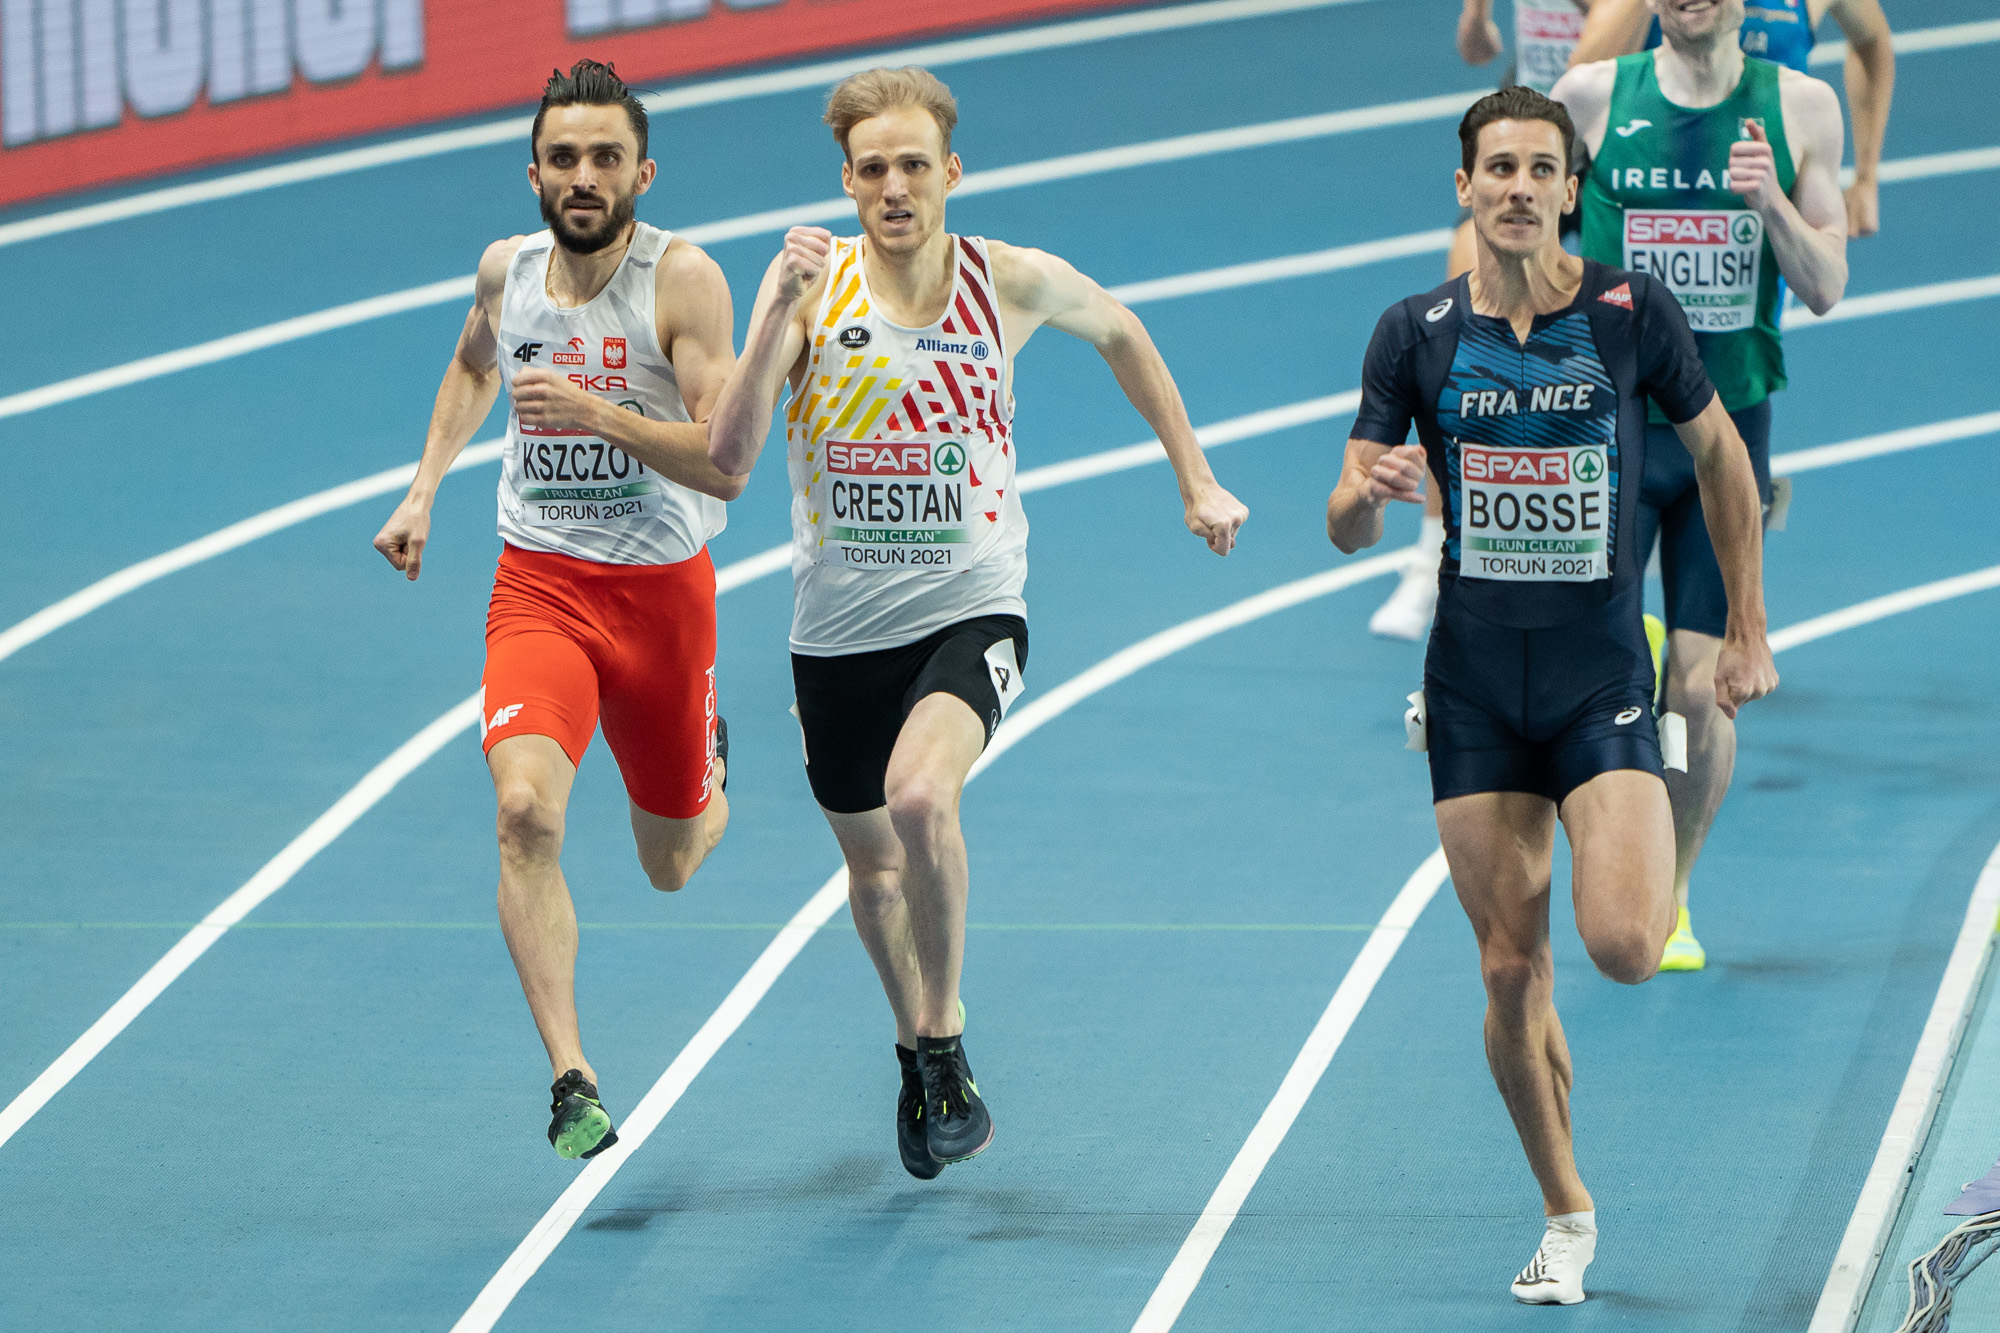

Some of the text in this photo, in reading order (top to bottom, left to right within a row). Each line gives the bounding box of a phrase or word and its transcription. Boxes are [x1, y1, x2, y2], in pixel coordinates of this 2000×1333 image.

[1611, 168, 1732, 190] IRELA
[1629, 217, 1726, 241] SPAR
[1631, 250, 1754, 286] ENGLISH
[1708, 311, 1742, 326] 2021
[513, 343, 543, 362] 4F
[915, 338, 968, 354] Allianz
[554, 353, 584, 364] ORLEN
[568, 373, 628, 391] SKA
[1459, 384, 1595, 419] FRANCE
[828, 446, 928, 471] SPAR
[1465, 452, 1567, 482] SPAR
[551, 489, 578, 499] RUN
[832, 480, 962, 523] CRESTAN
[538, 501, 643, 520] TORUŃ 2021
[1469, 489, 1601, 533] BOSSE
[857, 531, 886, 542] RUN
[1496, 540, 1526, 552] RUN
[841, 546, 951, 564] TORUŃ 2021
[1480, 557, 1593, 575] TORUŃ 2021
[488, 703, 524, 731] 4F
